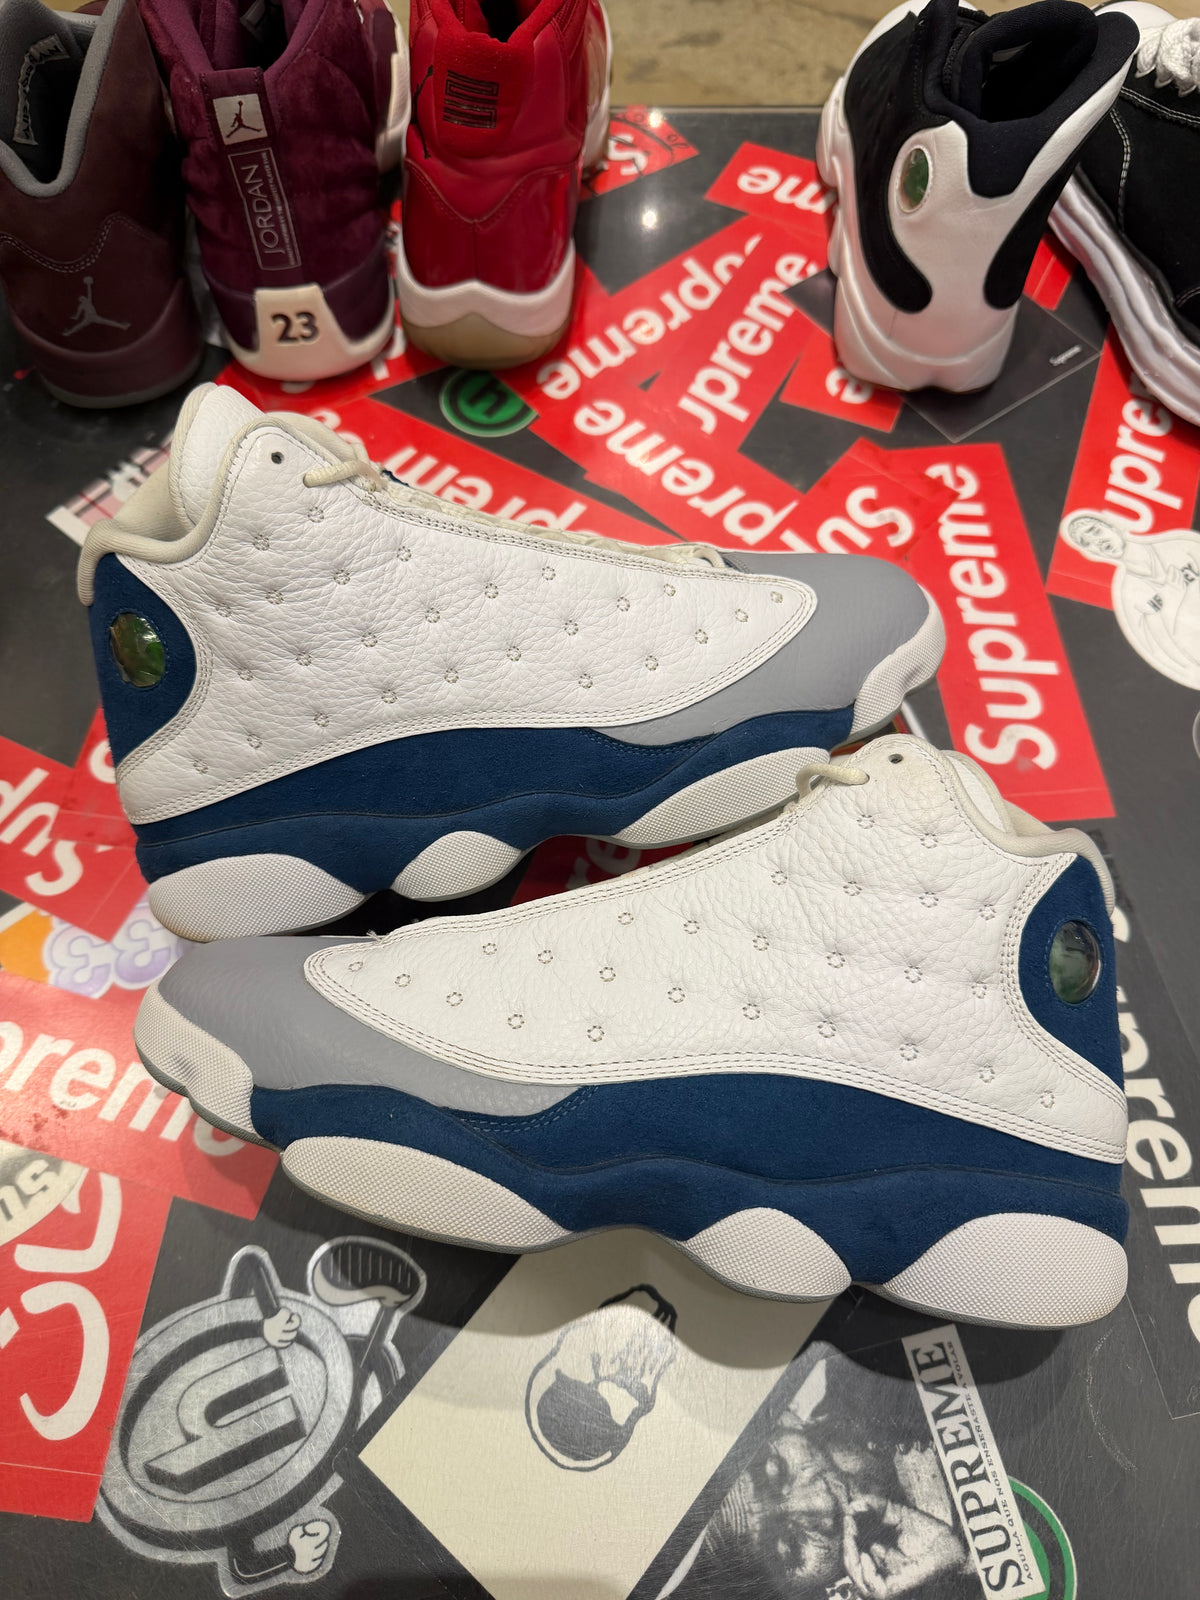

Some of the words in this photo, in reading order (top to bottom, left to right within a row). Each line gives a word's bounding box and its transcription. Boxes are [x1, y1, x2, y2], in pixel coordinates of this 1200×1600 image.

[241, 164, 286, 254] JORDAN
[271, 311, 319, 344] 23
[925, 463, 1059, 770] Supreme
[911, 1341, 1025, 1591] SUPREME
[991, 1470, 1004, 1496] NOS
[1001, 1499, 1015, 1527] QUE
